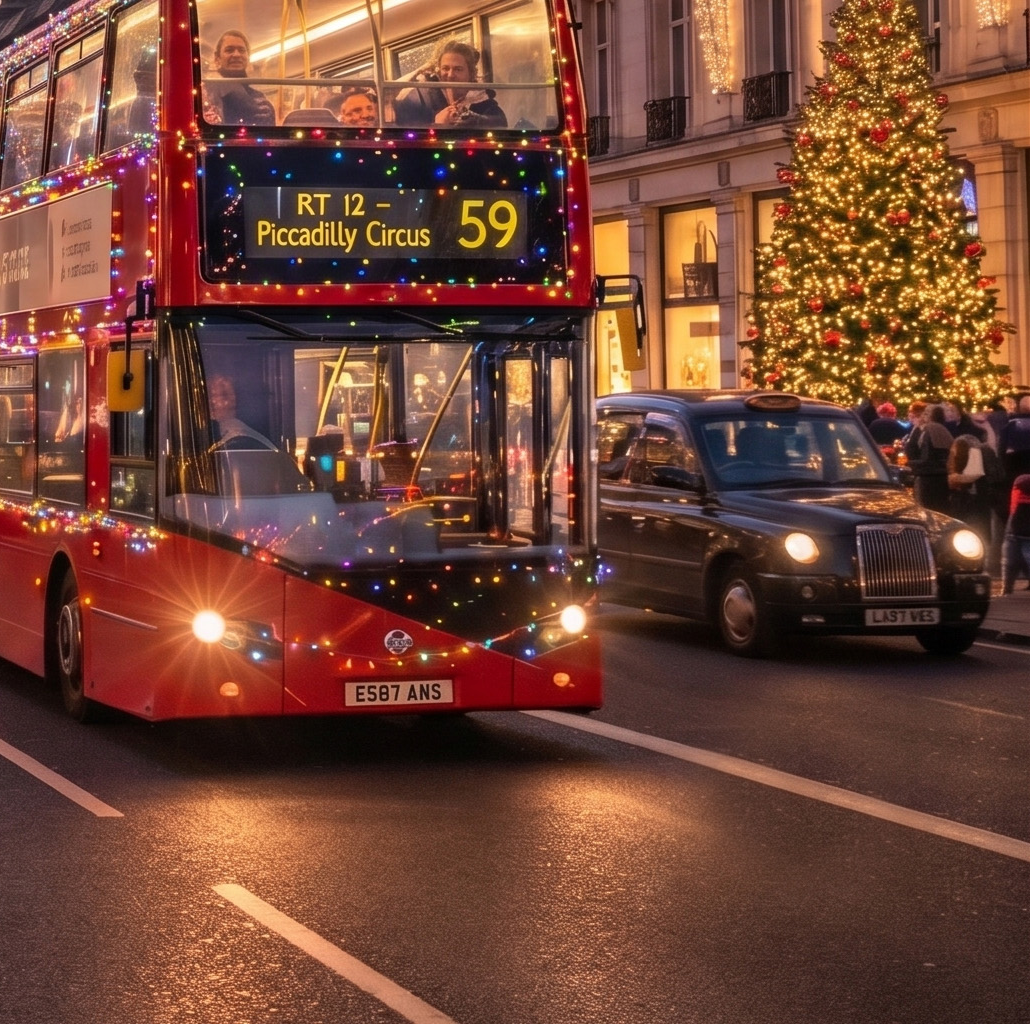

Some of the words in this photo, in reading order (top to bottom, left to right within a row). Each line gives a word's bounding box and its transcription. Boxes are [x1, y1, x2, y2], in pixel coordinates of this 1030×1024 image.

[297, 192, 332, 216] RT
[344, 192, 366, 217] 12
[257, 220, 358, 254] Piccadilly
[365, 220, 431, 247] Circus
[458, 199, 518, 249] 59
[356, 684, 400, 702] E587
[407, 683, 441, 701] ANS
